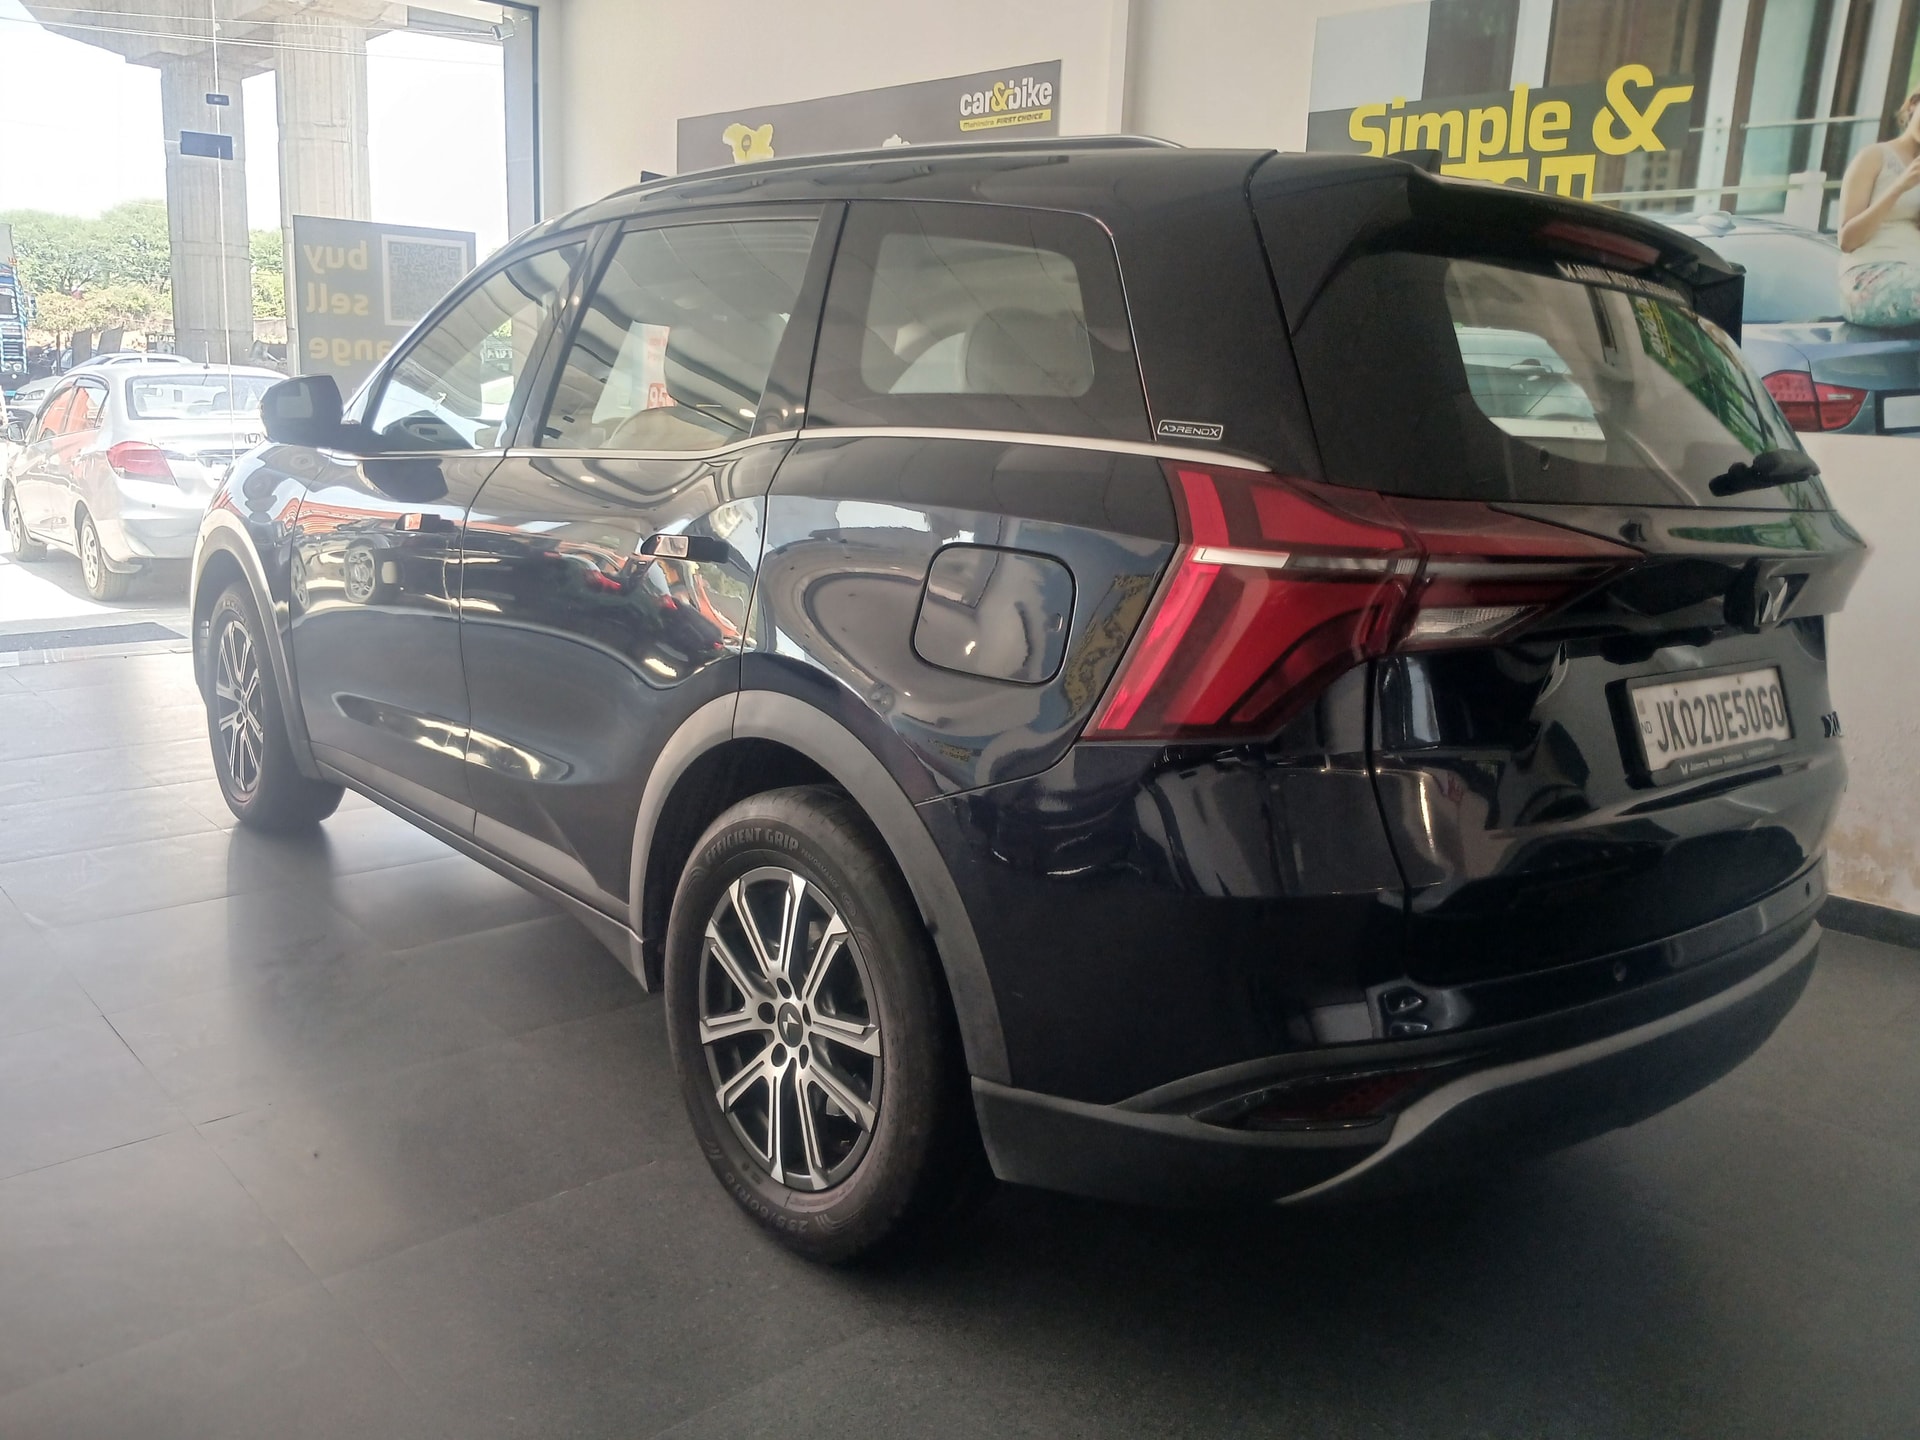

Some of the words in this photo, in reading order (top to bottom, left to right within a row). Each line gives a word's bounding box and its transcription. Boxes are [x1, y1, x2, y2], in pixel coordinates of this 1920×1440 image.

[960, 77, 1053, 116] car&bike
[1349, 83, 1571, 164] Simple
[1592, 64, 1695, 155] &
[1161, 425, 1220, 437] ADRENOX
[1656, 684, 1786, 753] JK02DE5060
[704, 827, 762, 864] EFFICIENT
[764, 829, 799, 851] GRIP
